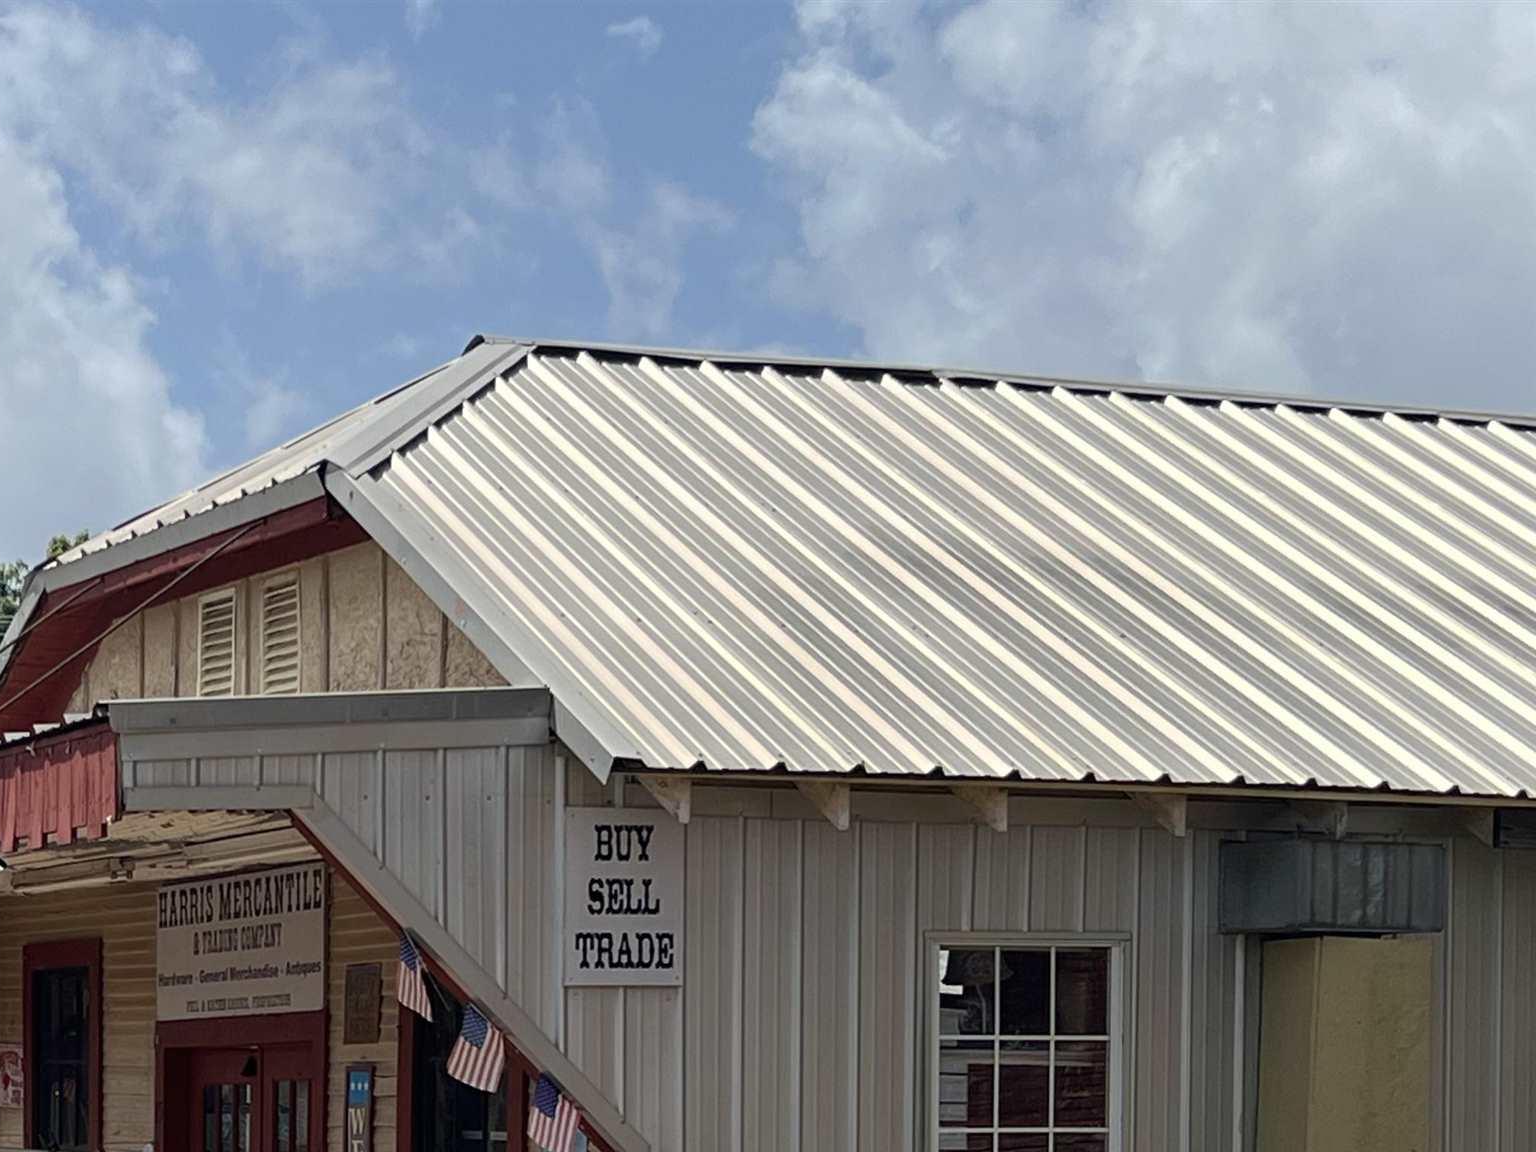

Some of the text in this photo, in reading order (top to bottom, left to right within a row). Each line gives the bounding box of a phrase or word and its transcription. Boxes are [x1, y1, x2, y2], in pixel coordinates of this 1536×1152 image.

[594, 824, 654, 861] BUY
[159, 869, 322, 928] HARRIS MERCANTILE
[587, 877, 660, 915] SELL
[193, 923, 282, 955] & TRADING COMPANY
[575, 932, 674, 969] TRADE
[158, 961, 322, 987] Hardware General Merchandise Antiques
